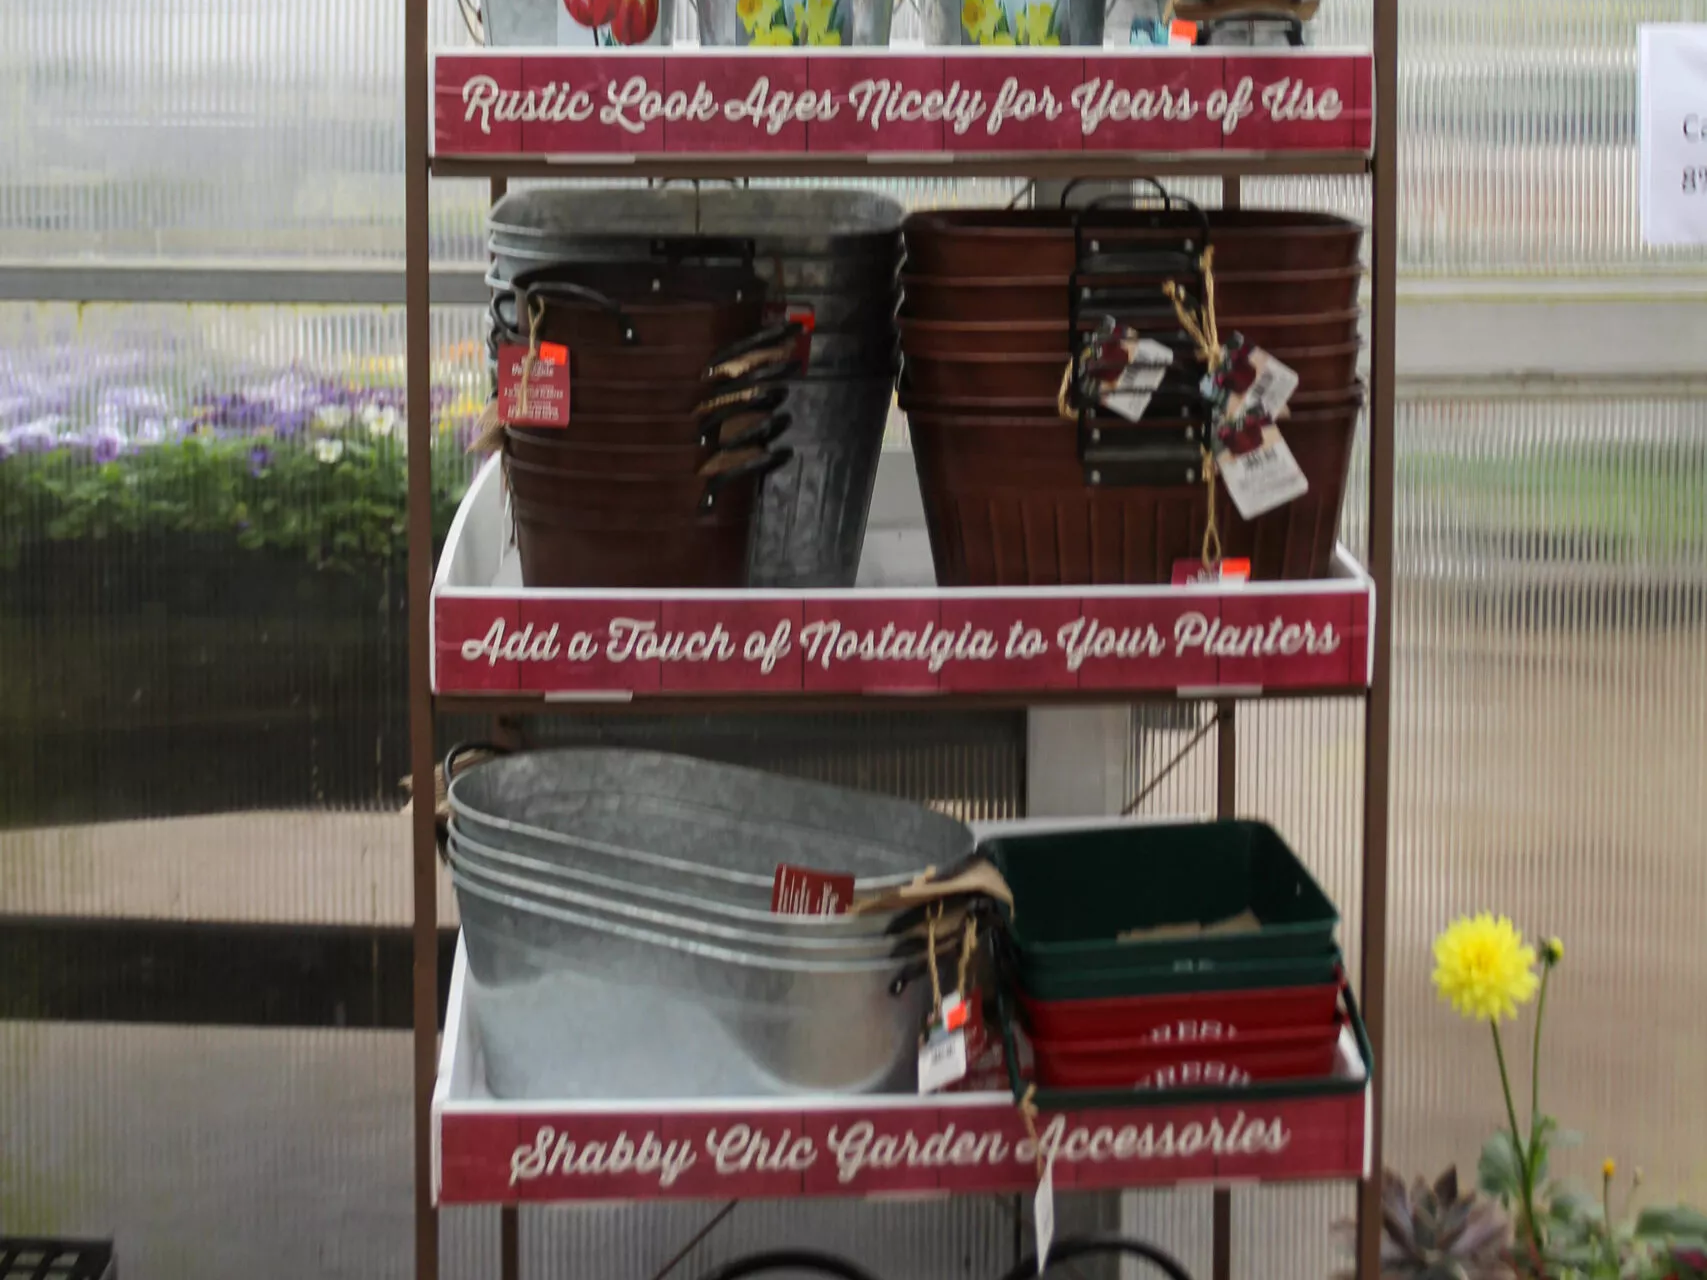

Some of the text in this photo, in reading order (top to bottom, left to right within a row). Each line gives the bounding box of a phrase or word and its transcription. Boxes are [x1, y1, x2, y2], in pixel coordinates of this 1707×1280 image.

[462, 75, 1343, 135] Rustic Look Ages Nicely for Years of Use
[461, 612, 1341, 675] Add a Touch of Nostalgia to Your Planters
[509, 1110, 1291, 1188] Shabby Chic Garden Accessories
